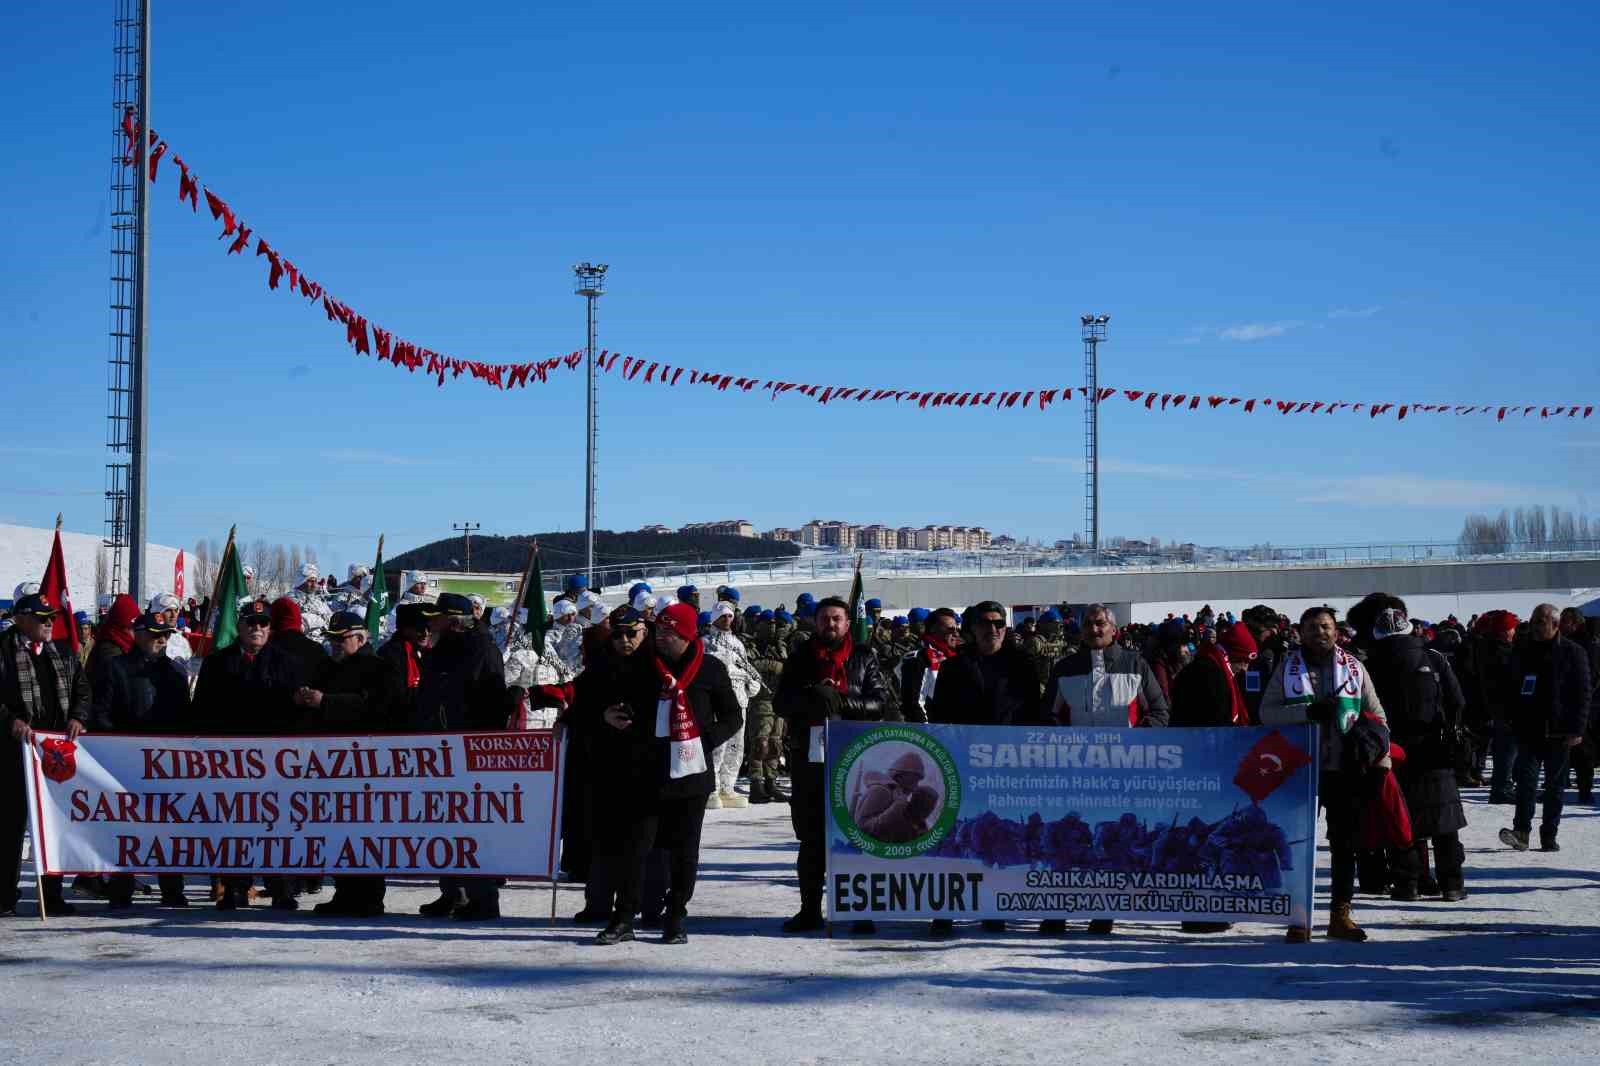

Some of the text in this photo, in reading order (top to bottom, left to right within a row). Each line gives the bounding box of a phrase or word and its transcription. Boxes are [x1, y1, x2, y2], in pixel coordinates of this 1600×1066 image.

[1027, 732, 1047, 743] 22
[1050, 732, 1088, 744] Aralık
[141, 740, 456, 780] KIBRIS GAZİLERİ
[476, 751, 545, 769] DERNEĞİ
[968, 775, 1221, 792] Şehitlerimizin Hakk'a yürüyüşlerini
[70, 783, 525, 831] SARIKAMIŞ ŞEHİTLERİNİ
[988, 794, 1041, 808] Rahmet
[1047, 797, 1064, 807] ve
[1067, 793, 1130, 808] minnetle
[115, 835, 480, 869] RAHMETLE ANIYOR
[885, 846, 912, 857] 2009
[1026, 871, 1264, 891] SARIKAMIŞ YARDIMLAŞMA
[835, 873, 983, 912] ESENYURT
[998, 893, 1104, 912] DAYANIŞMA
[1106, 894, 1130, 909] VE
[1135, 891, 1208, 911] KÜLTÜR
